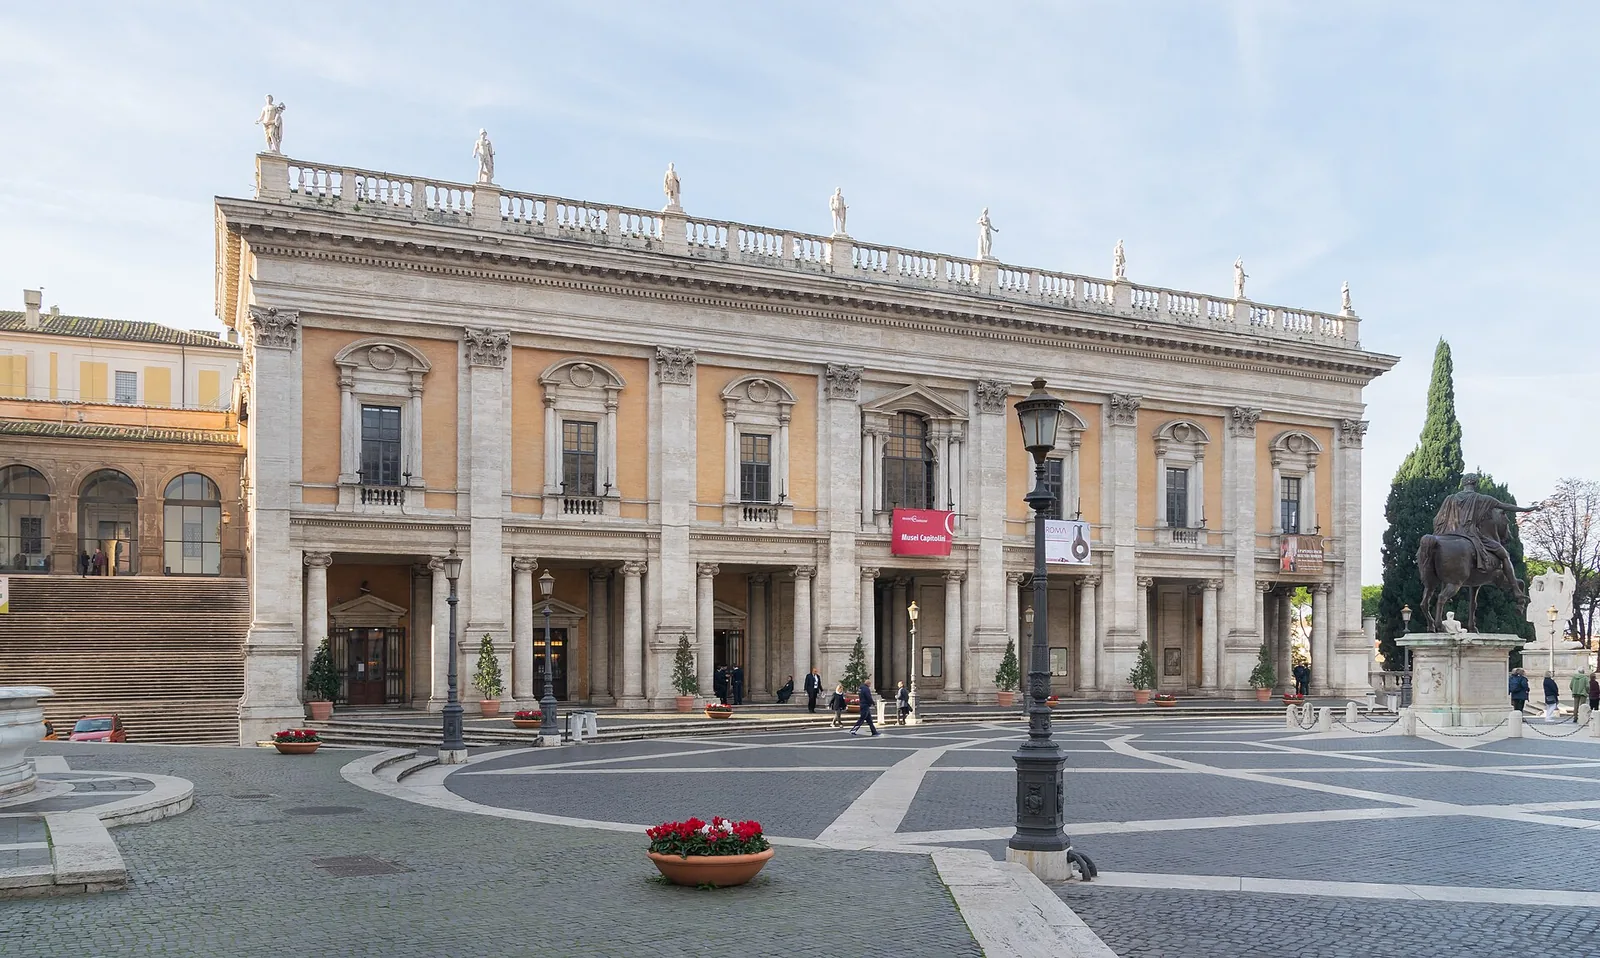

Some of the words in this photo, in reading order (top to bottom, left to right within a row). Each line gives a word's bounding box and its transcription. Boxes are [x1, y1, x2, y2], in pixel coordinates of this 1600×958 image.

[1046, 526, 1067, 534] ROMA
[901, 533, 919, 541] Musei
[920, 534, 946, 542] Capitolini
